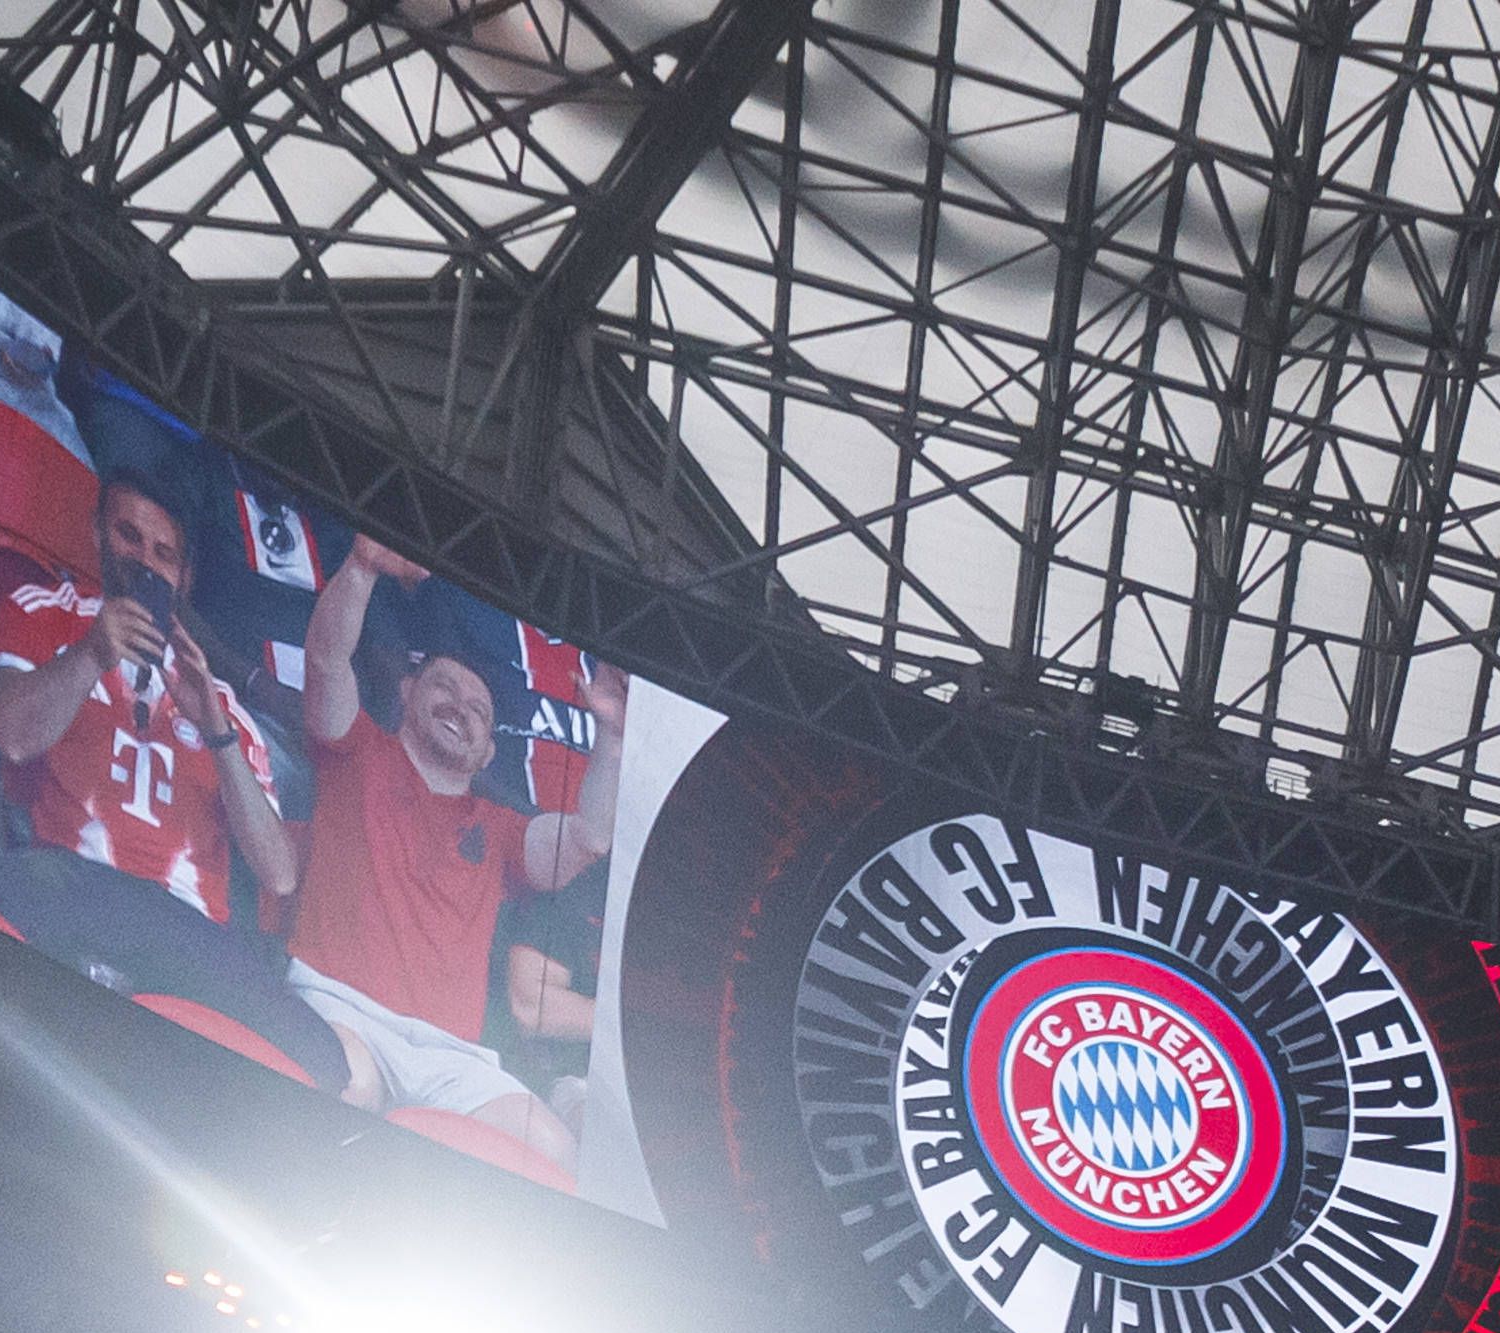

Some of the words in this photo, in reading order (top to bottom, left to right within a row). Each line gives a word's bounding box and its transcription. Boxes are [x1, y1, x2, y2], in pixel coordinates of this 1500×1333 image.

[1022, 1014, 1074, 1070] FC
[1074, 1000, 1232, 1110] BAYERN
[1019, 1106, 1228, 1214] MÜNCHEN
